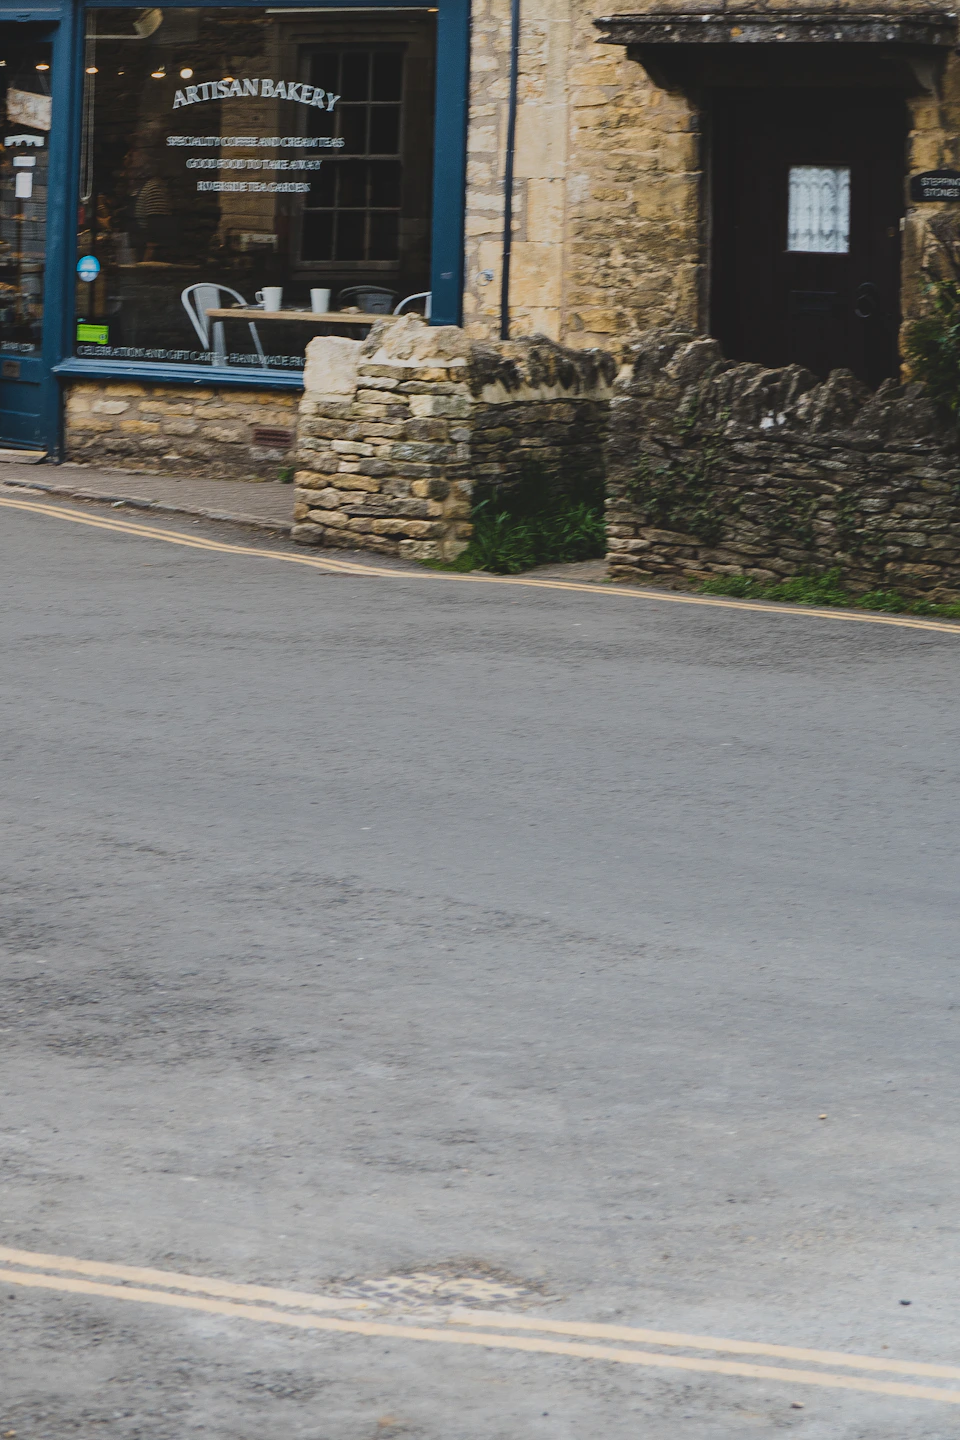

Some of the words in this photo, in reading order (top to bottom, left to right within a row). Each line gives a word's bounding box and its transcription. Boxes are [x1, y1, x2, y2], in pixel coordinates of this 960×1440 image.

[171, 78, 260, 109] ARTISAN
[260, 78, 342, 112] BAKERY
[221, 136, 259, 147] COFFEE
[258, 137, 281, 147] AND
[281, 137, 319, 148] CREAM
[319, 137, 346, 148] TEAS
[186, 158, 217, 169] GOOD
[217, 158, 246, 170] FOOD
[247, 158, 262, 170] TO
[262, 159, 289, 170] TAKE
[288, 159, 322, 170] AWAY
[196, 181, 247, 192] RIVERSIDE
[247, 181, 267, 192] TEA
[267, 182, 311, 193] GARDEN
[923, 188, 960, 197] STONES
[77, 345, 146, 358] CELEBRATION
[144, 348, 167, 359] AND
[166, 349, 191, 360] GIFT
[190, 351, 224, 362] CAKE
[229, 352, 288, 366] HANDMADE
